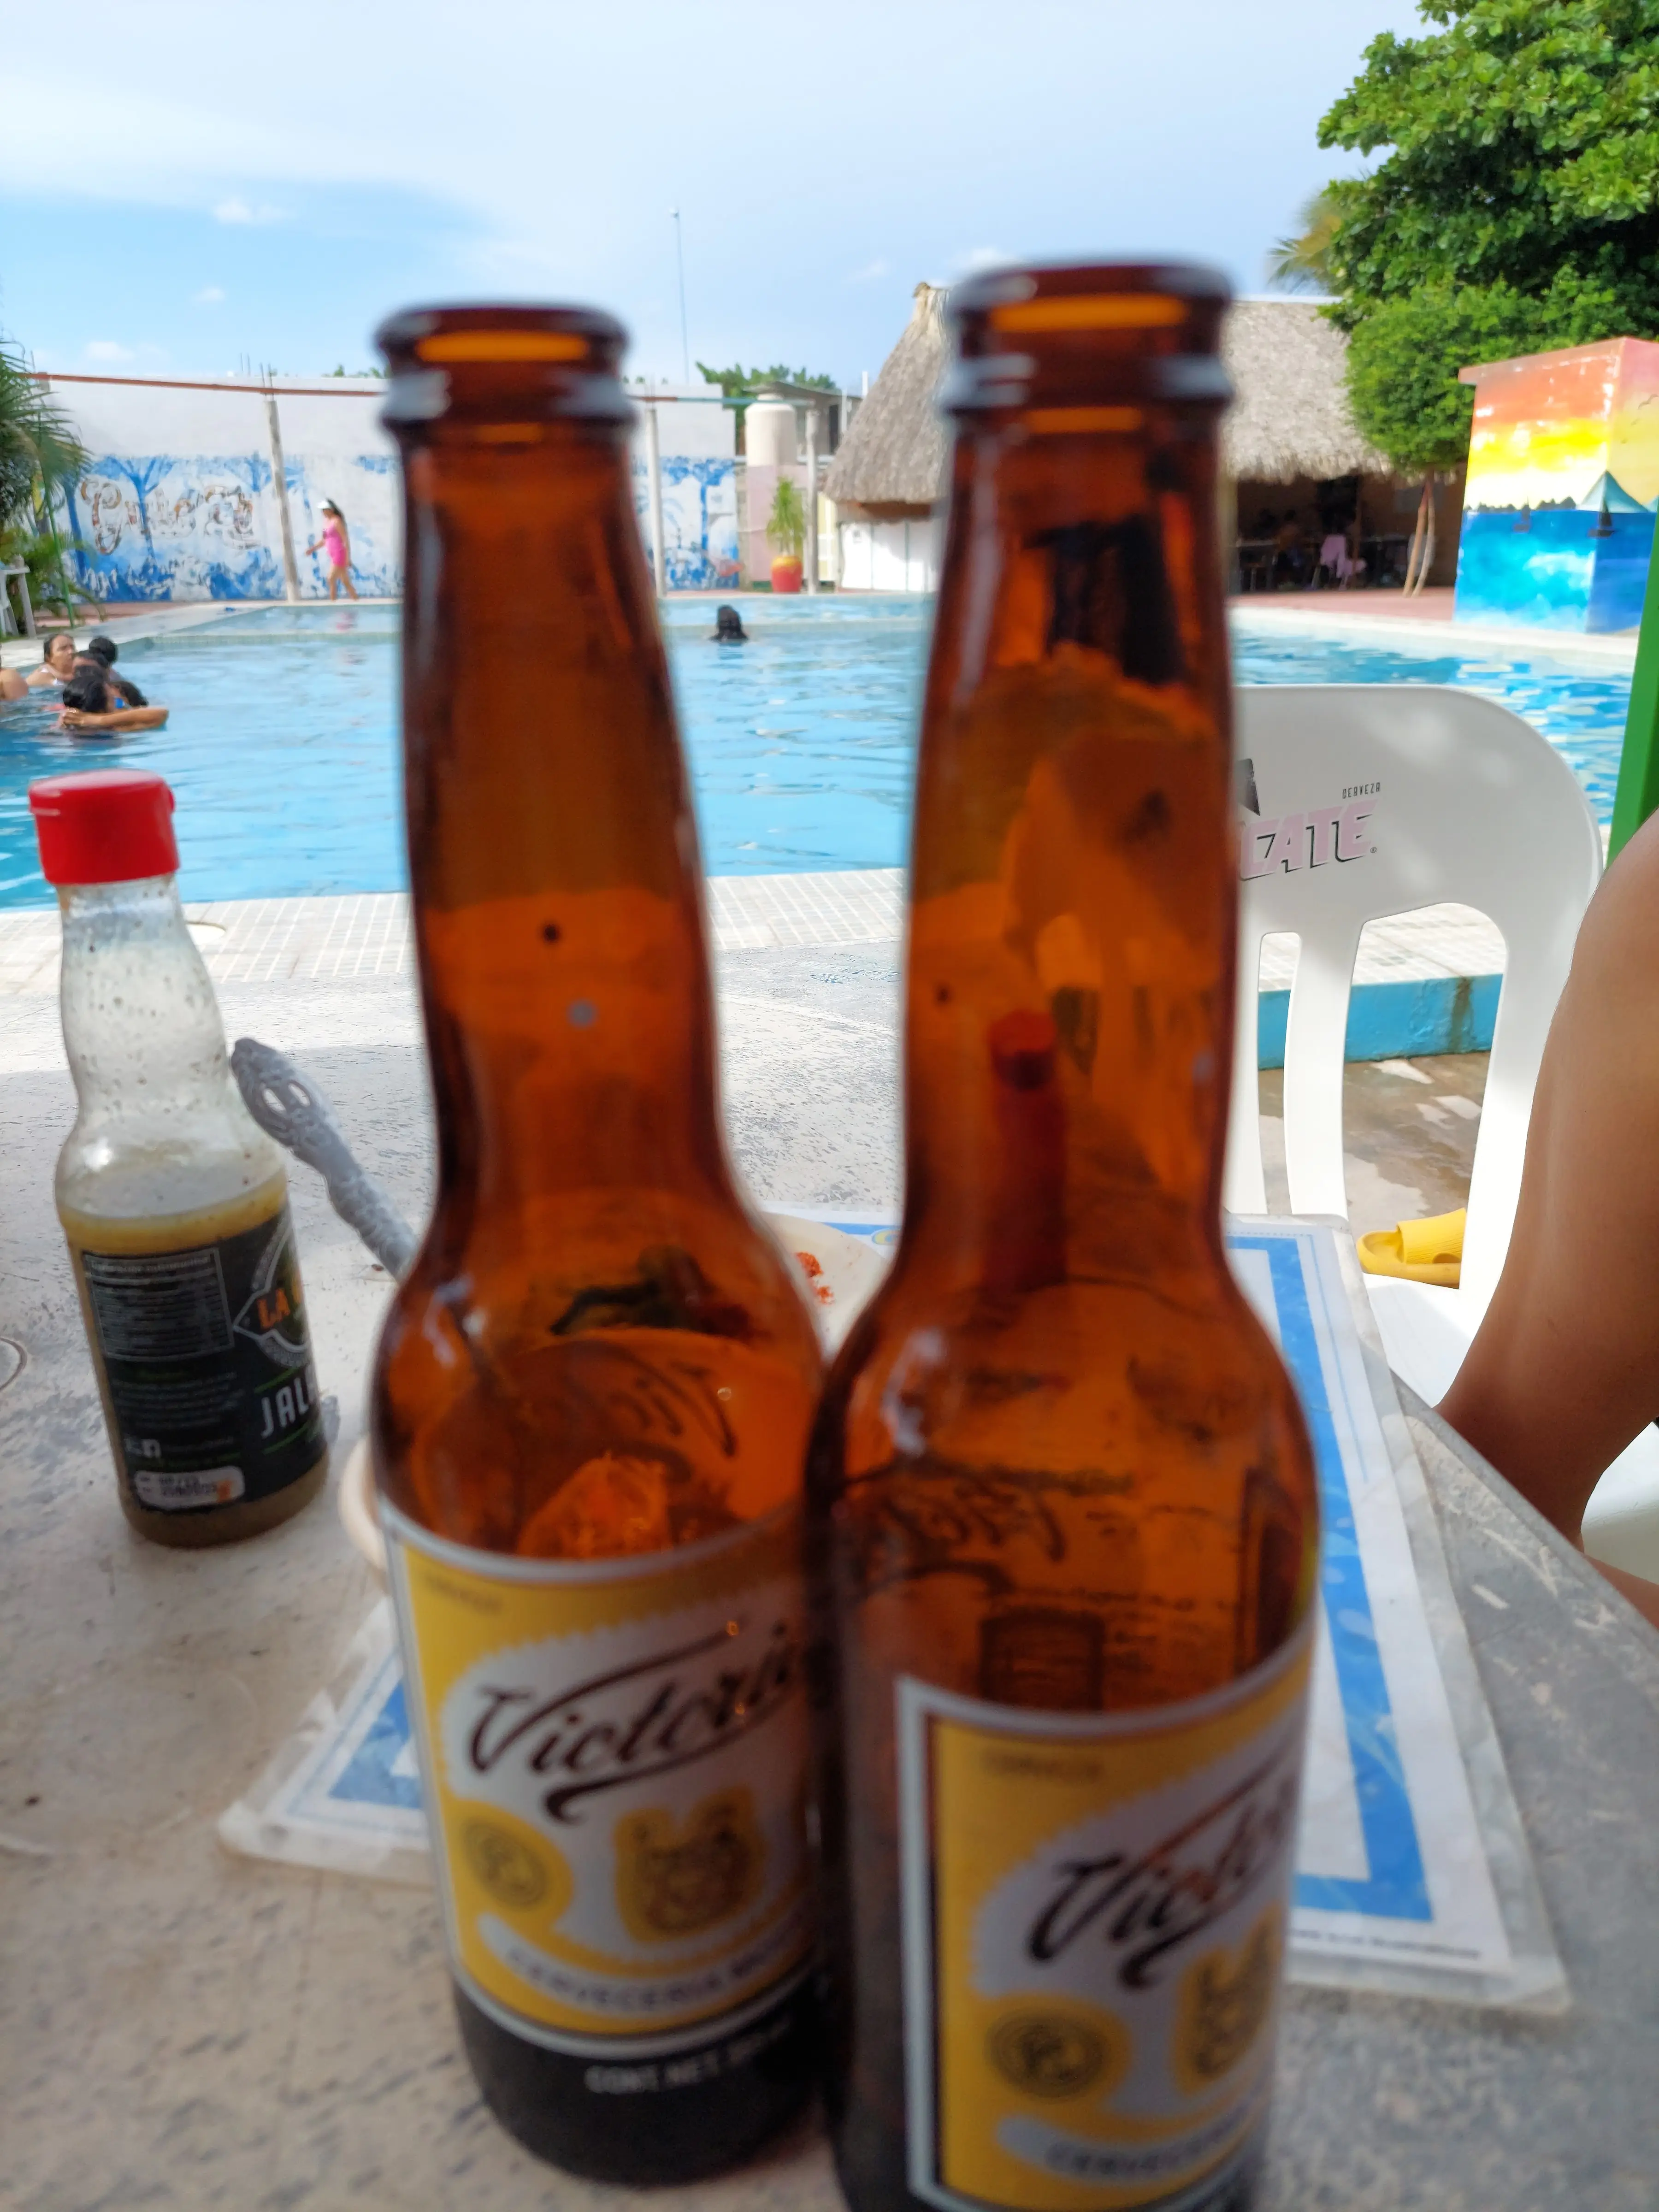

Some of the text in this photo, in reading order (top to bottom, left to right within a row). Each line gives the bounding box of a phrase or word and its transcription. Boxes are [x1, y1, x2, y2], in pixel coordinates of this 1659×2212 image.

[1342, 782, 1381, 799] CERVEZA
[1240, 799, 1378, 881] CATE
[257, 1288, 290, 1330] LA
